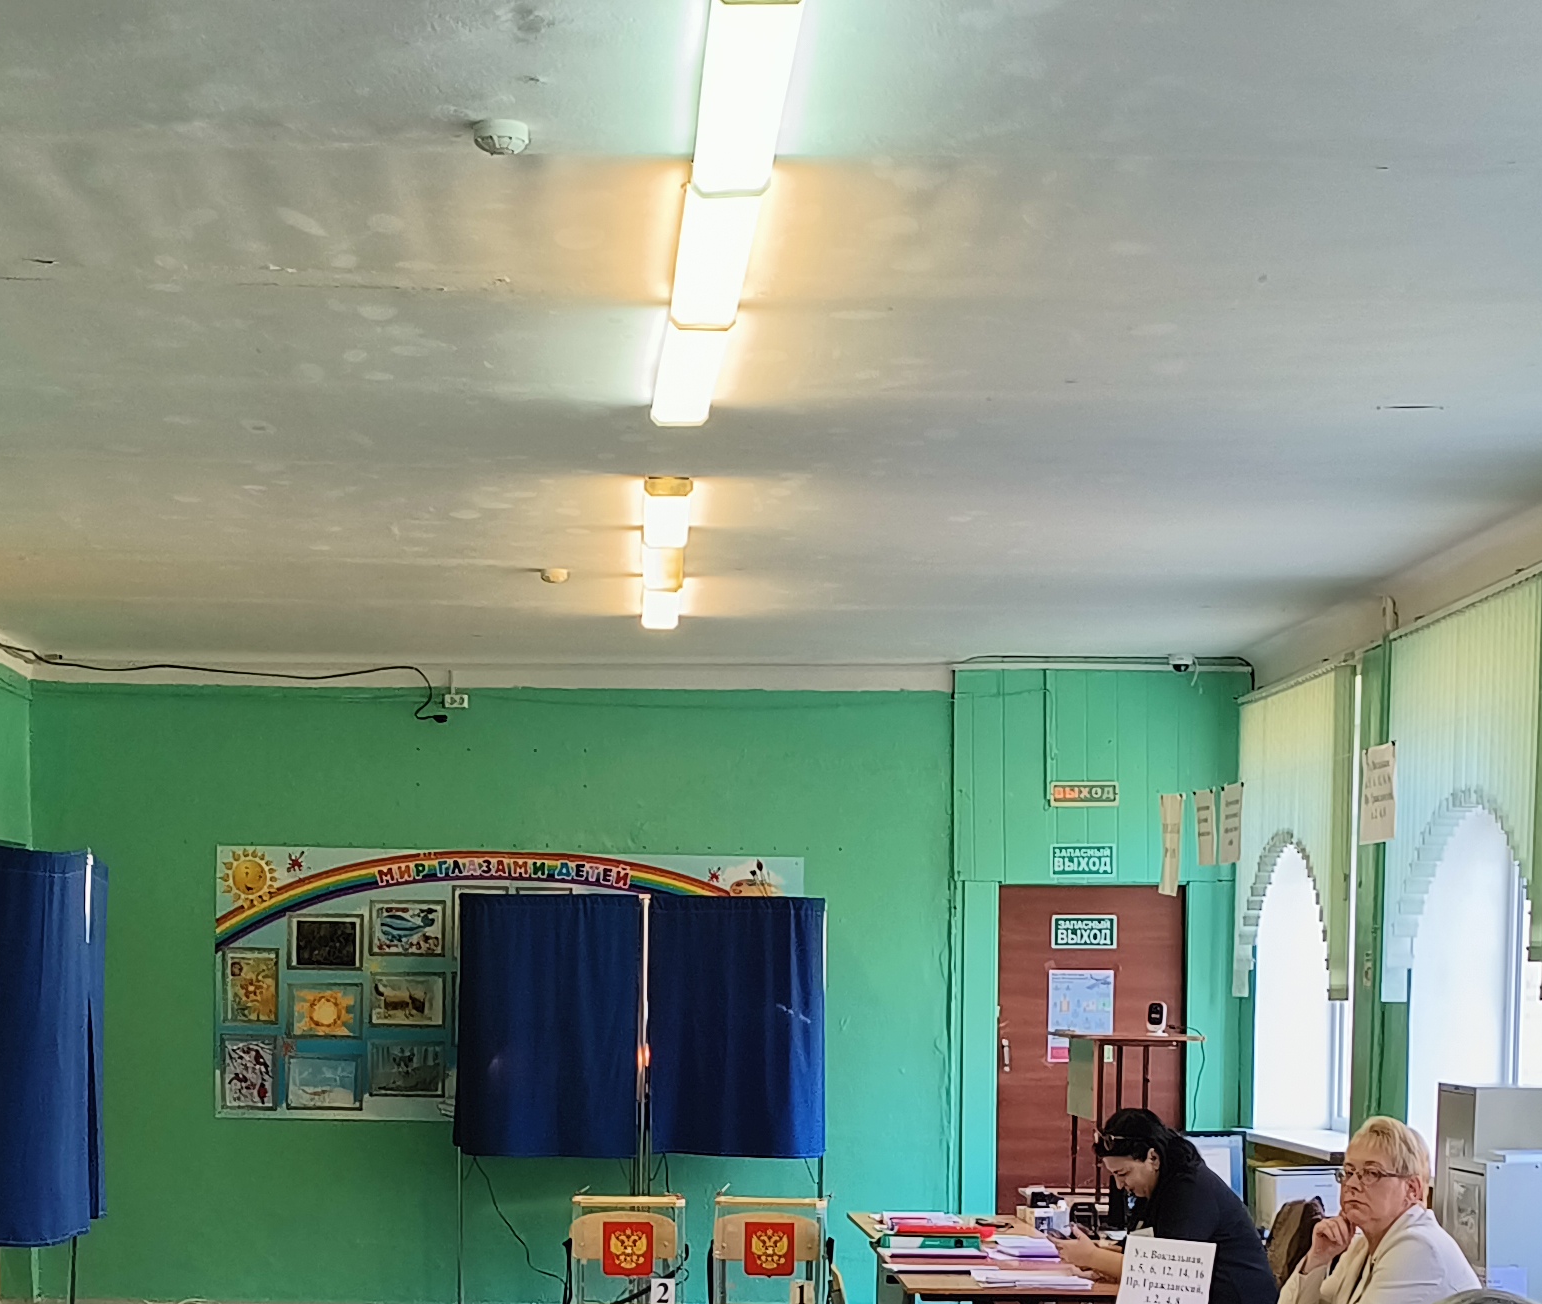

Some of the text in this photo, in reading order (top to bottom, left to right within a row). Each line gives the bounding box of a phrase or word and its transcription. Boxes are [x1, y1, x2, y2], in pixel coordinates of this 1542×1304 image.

[1054, 786, 1115, 800] ВЫХОД
[1054, 847, 1111, 857] ЗАПАСНЫЙ
[1054, 857, 1111, 873] ВЫХОД
[377, 858, 631, 889] МИР ГЛАЗАМИ ДЕТЕЙ
[1058, 919, 1111, 930] ЗАПАСНЫЙ
[1057, 929, 1111, 945] ВЫХОД
[1151, 1250, 1204, 1265] Вокзальная,
[1195, 1269, 1205, 1279] 16
[657, 1282, 670, 1304] 2
[797, 1284, 805, 1304] 1
